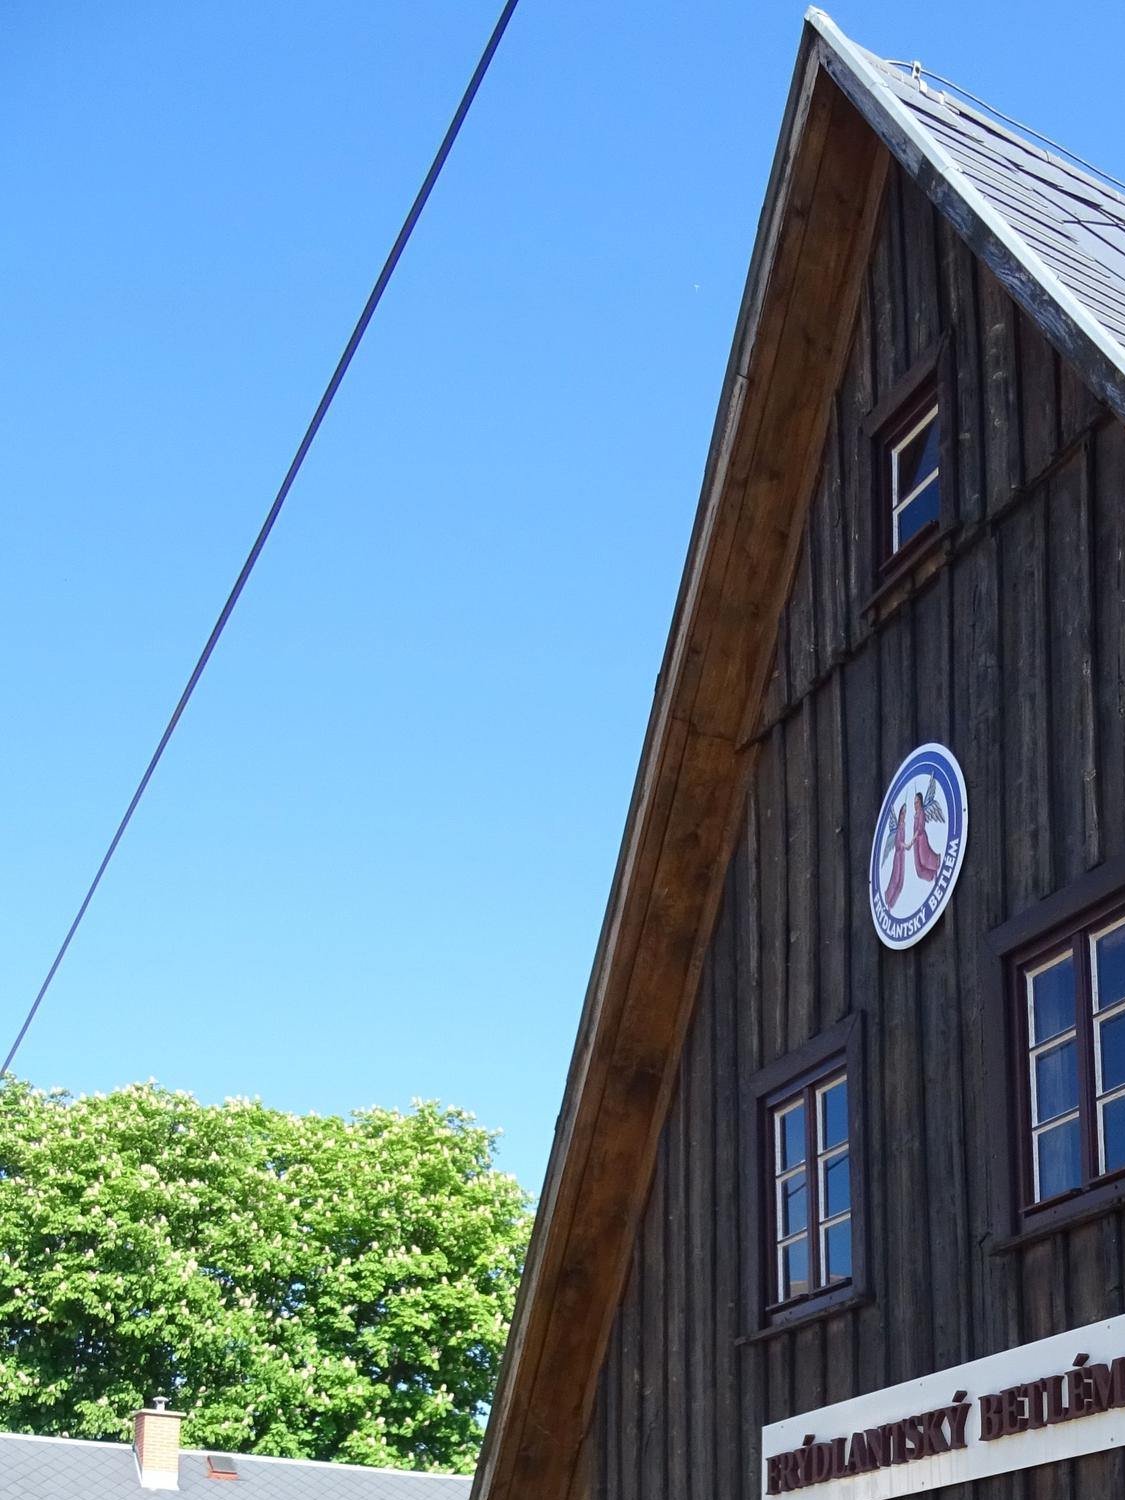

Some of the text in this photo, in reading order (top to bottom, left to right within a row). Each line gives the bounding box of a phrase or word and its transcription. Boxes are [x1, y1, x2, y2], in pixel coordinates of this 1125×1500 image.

[873, 837, 960, 939] FRÝDLANTSKÝ BETLÉM
[766, 1390, 972, 1495] FRÝDLANTSKÝ
